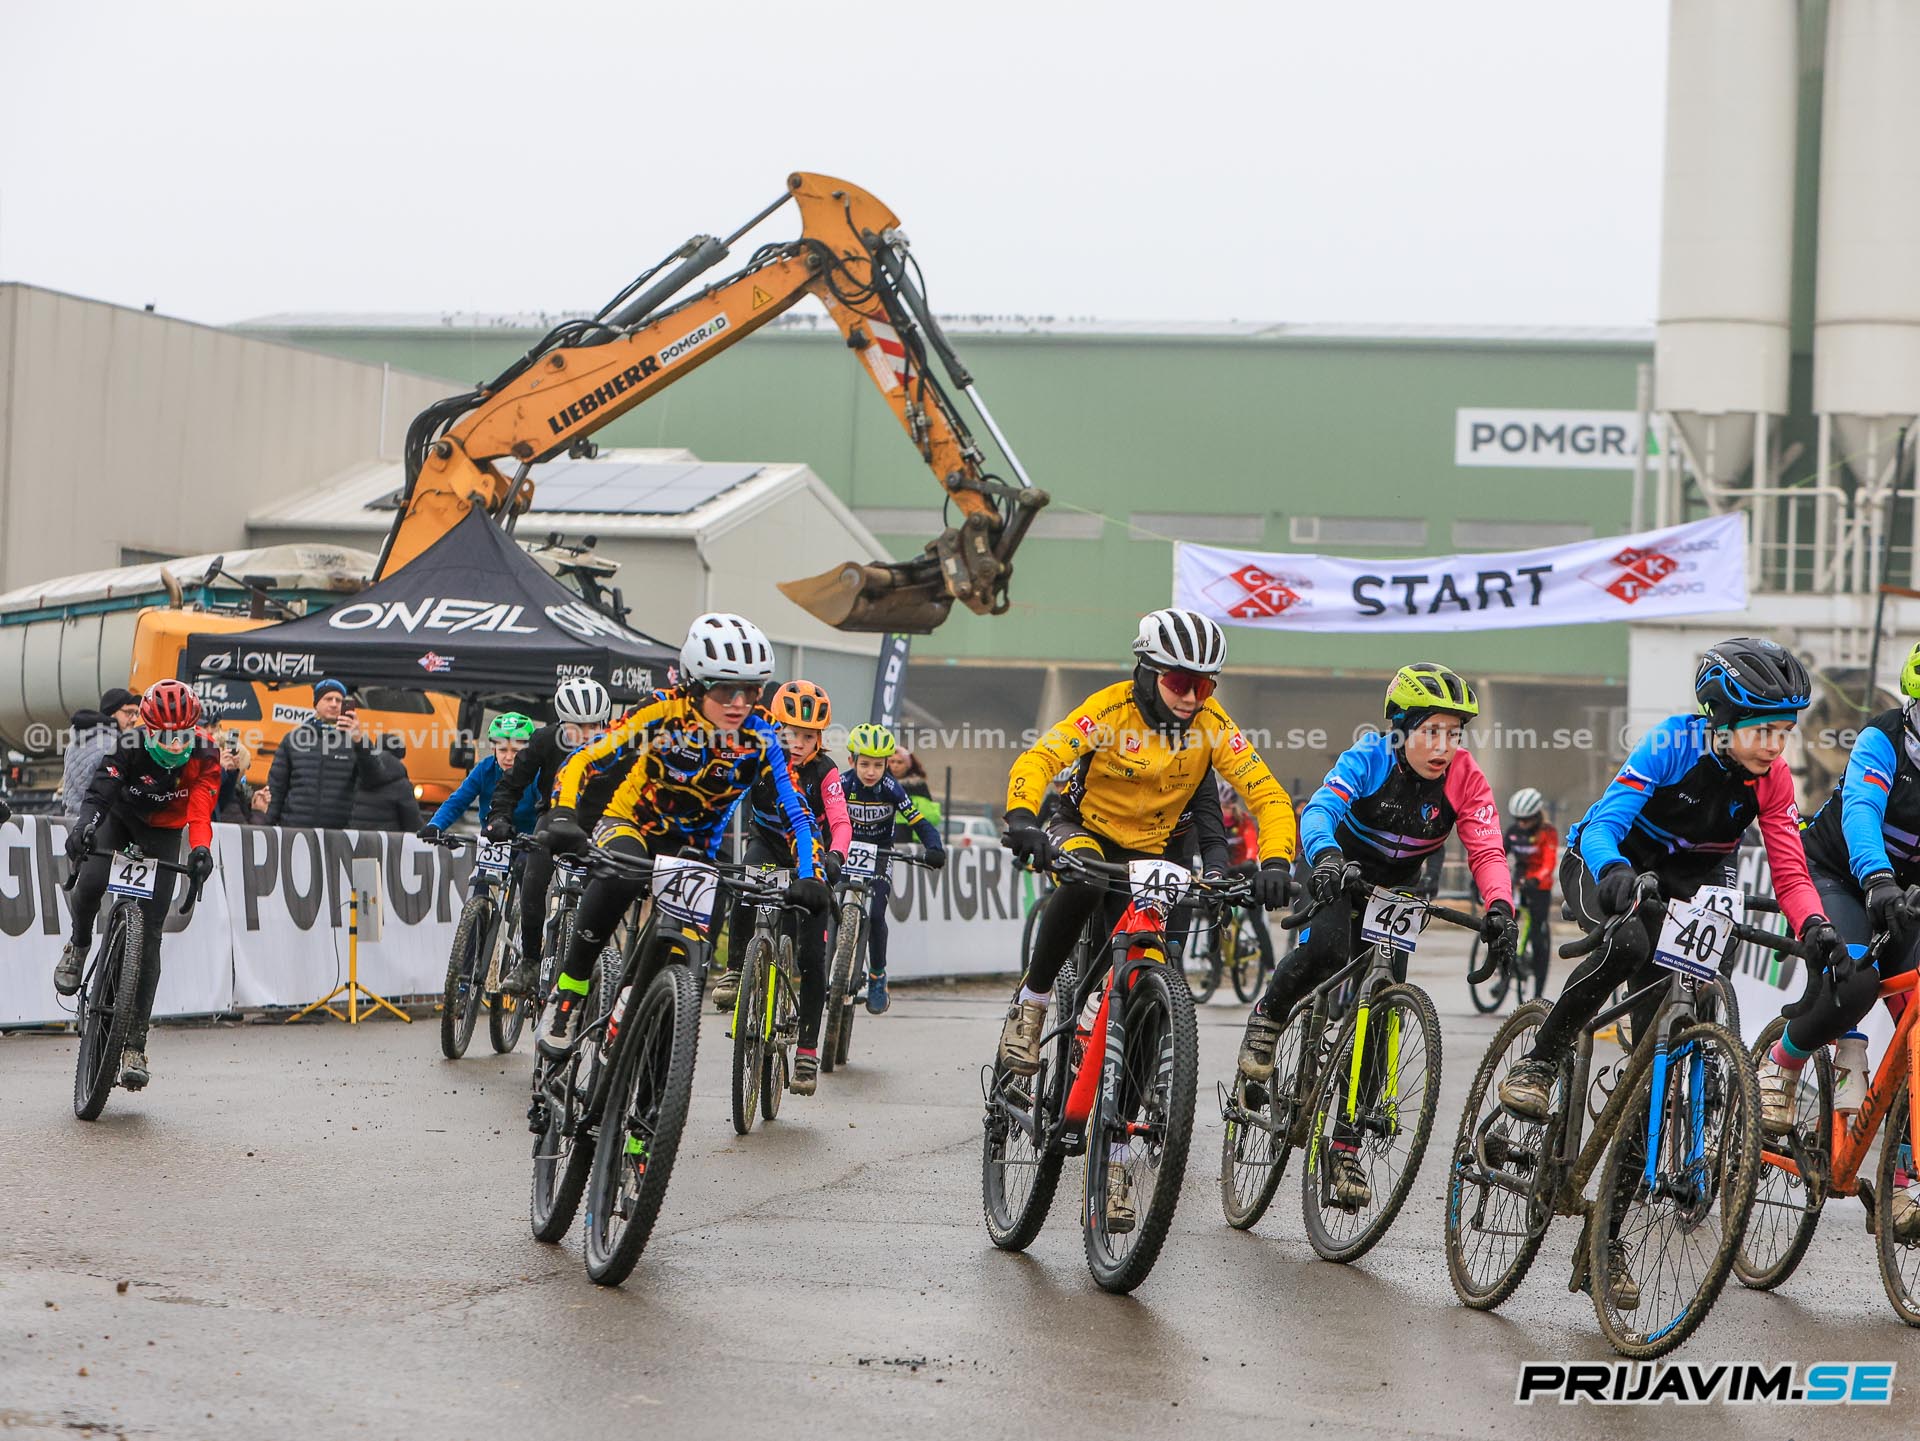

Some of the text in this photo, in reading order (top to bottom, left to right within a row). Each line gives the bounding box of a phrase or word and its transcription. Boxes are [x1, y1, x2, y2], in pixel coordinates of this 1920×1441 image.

[660, 316, 726, 363] POMGRAD
[548, 355, 661, 435] LIEBHERR
[1470, 422, 1662, 456] POMGRA
[1352, 565, 1553, 616] START
[556, 664, 594, 676] ENJOY
[120, 863, 148, 888] 42
[848, 848, 870, 869] 52
[656, 869, 707, 907] 47
[1144, 868, 1181, 905] 46
[1375, 903, 1415, 936] 45
[1674, 918, 1717, 962] 40
